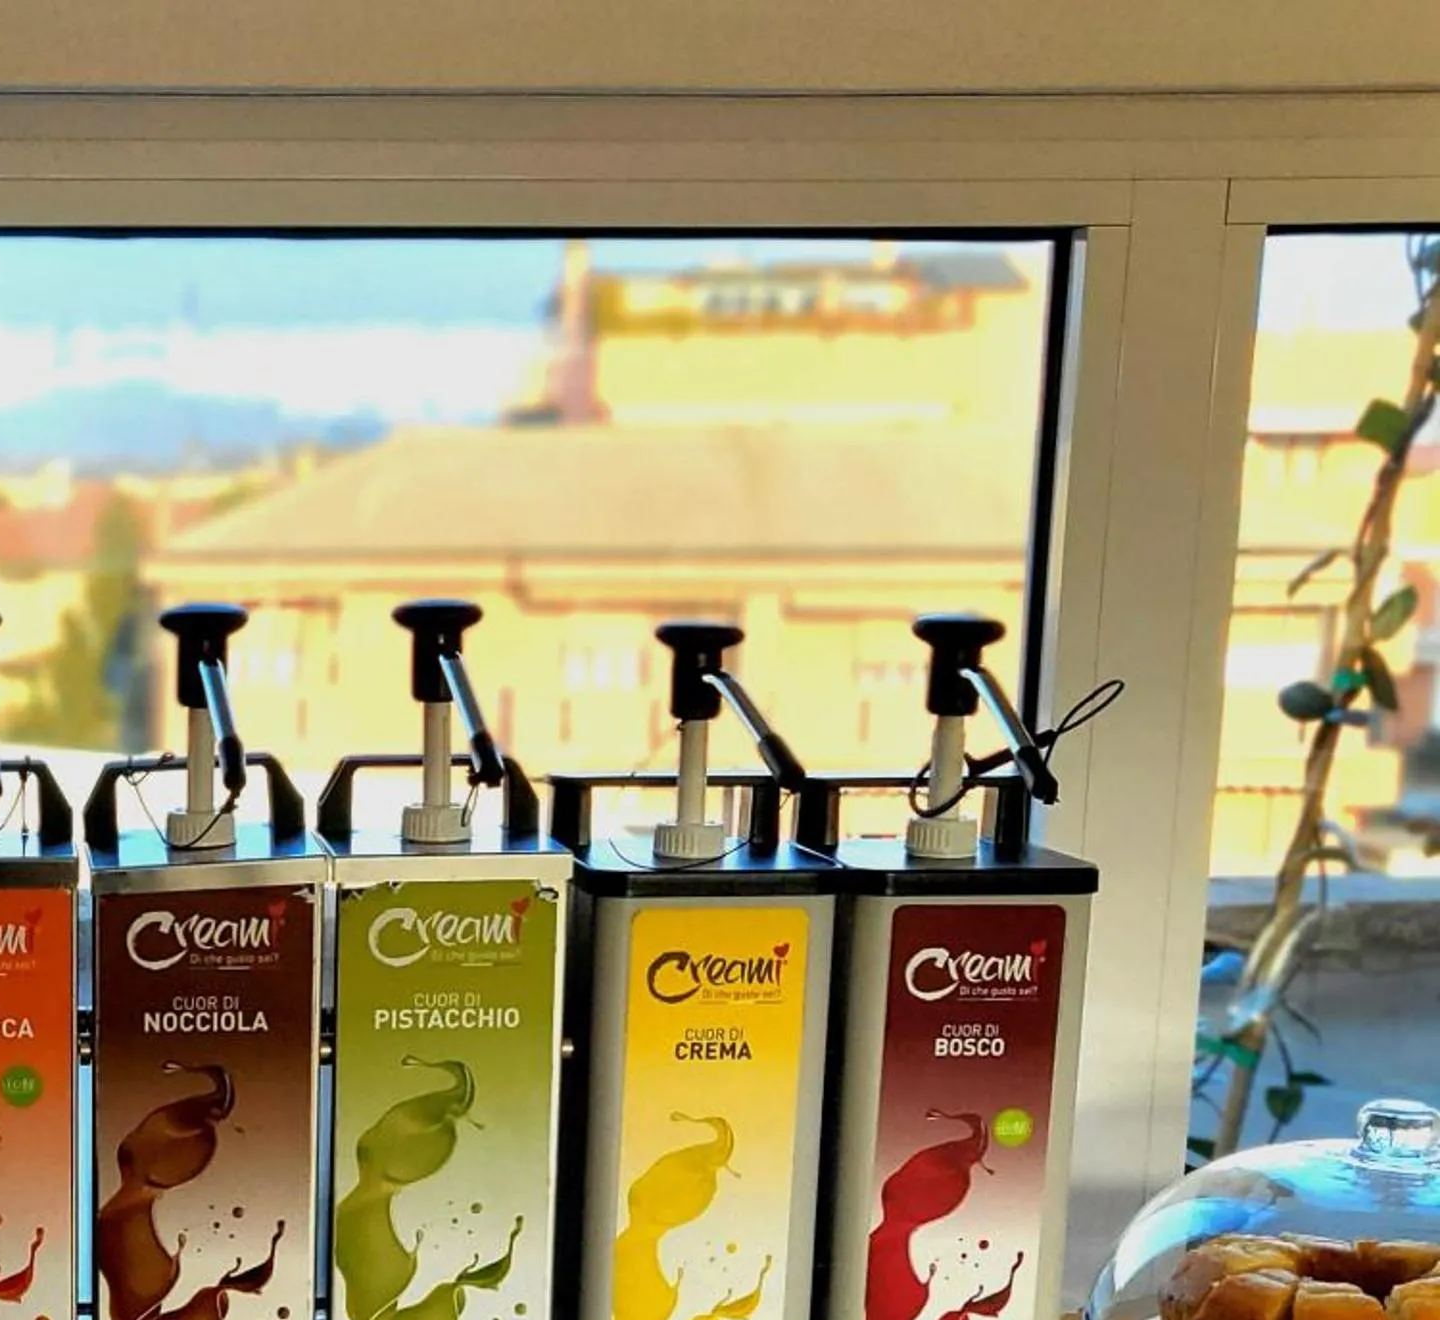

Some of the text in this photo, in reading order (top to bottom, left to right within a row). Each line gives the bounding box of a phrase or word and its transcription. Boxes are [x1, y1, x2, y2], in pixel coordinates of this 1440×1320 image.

[172, 996, 239, 1011] CUOR DI
[414, 992, 481, 1007] CUOR DI
[144, 1011, 268, 1033] NOCCIOLA
[375, 1007, 520, 1029] PISTACCHIO
[685, 1028, 744, 1041] CUOR DI
[942, 1024, 999, 1037] CUOR DI
[675, 1042, 752, 1060] CREMA
[934, 1038, 1005, 1057] BOSCO
